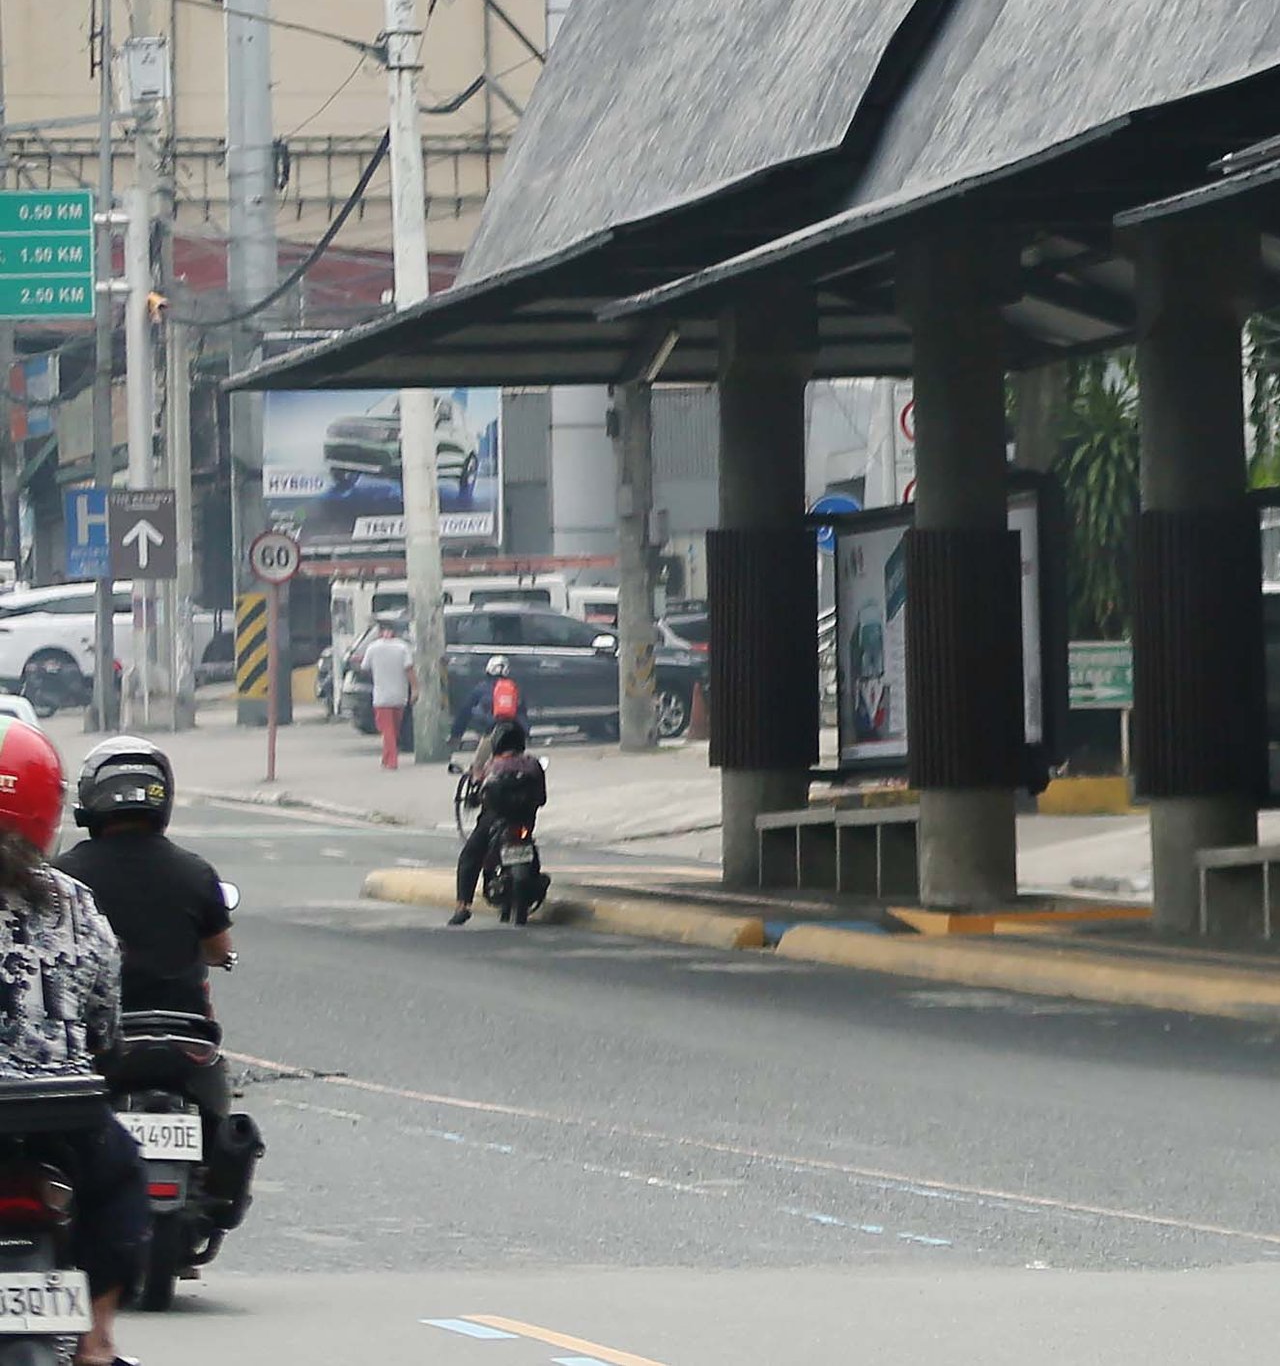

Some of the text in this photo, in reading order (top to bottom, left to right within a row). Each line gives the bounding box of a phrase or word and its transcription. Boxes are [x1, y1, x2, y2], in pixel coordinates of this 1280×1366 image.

[57, 202, 83, 220] KM
[57, 245, 84, 263] KM
[59, 286, 85, 304] KM
[260, 545, 290, 568] 60
